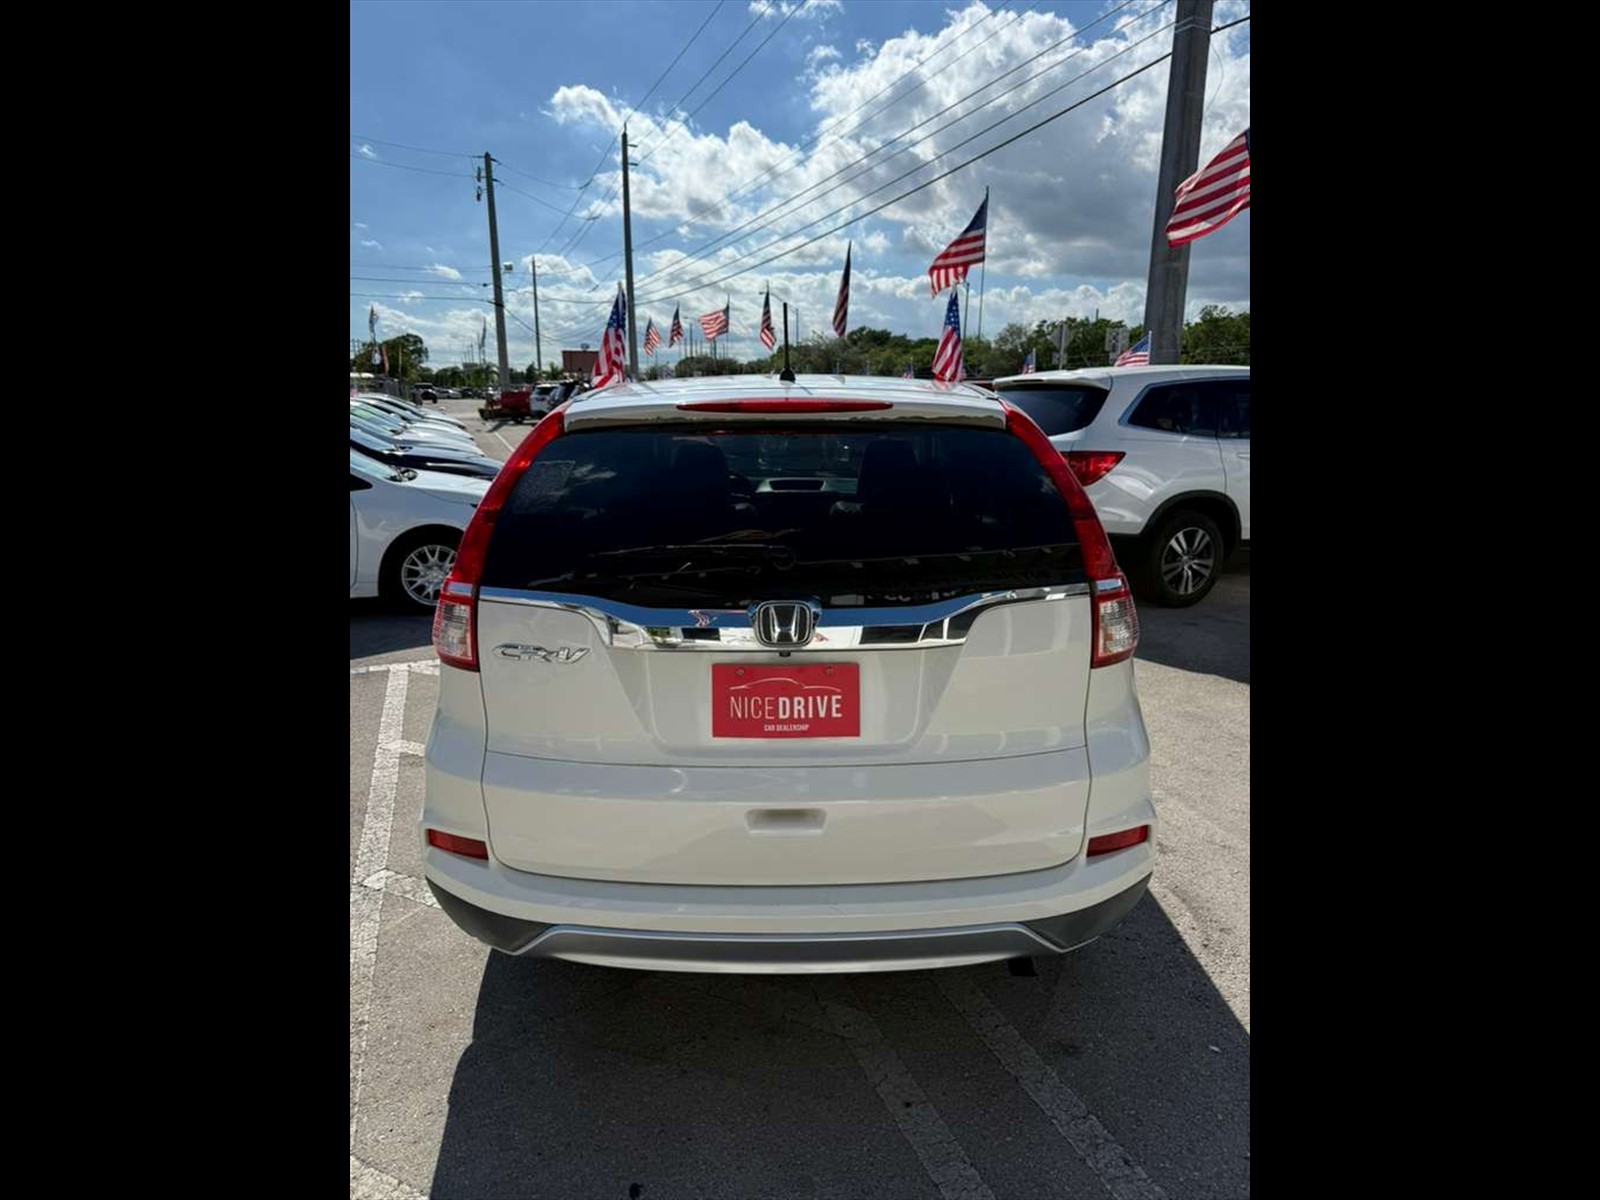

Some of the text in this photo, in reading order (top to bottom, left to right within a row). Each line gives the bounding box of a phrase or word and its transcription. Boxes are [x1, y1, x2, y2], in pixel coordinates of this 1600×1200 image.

[493, 643, 590, 664] CR-V
[764, 723, 809, 732] CAR DEALERSHIP
